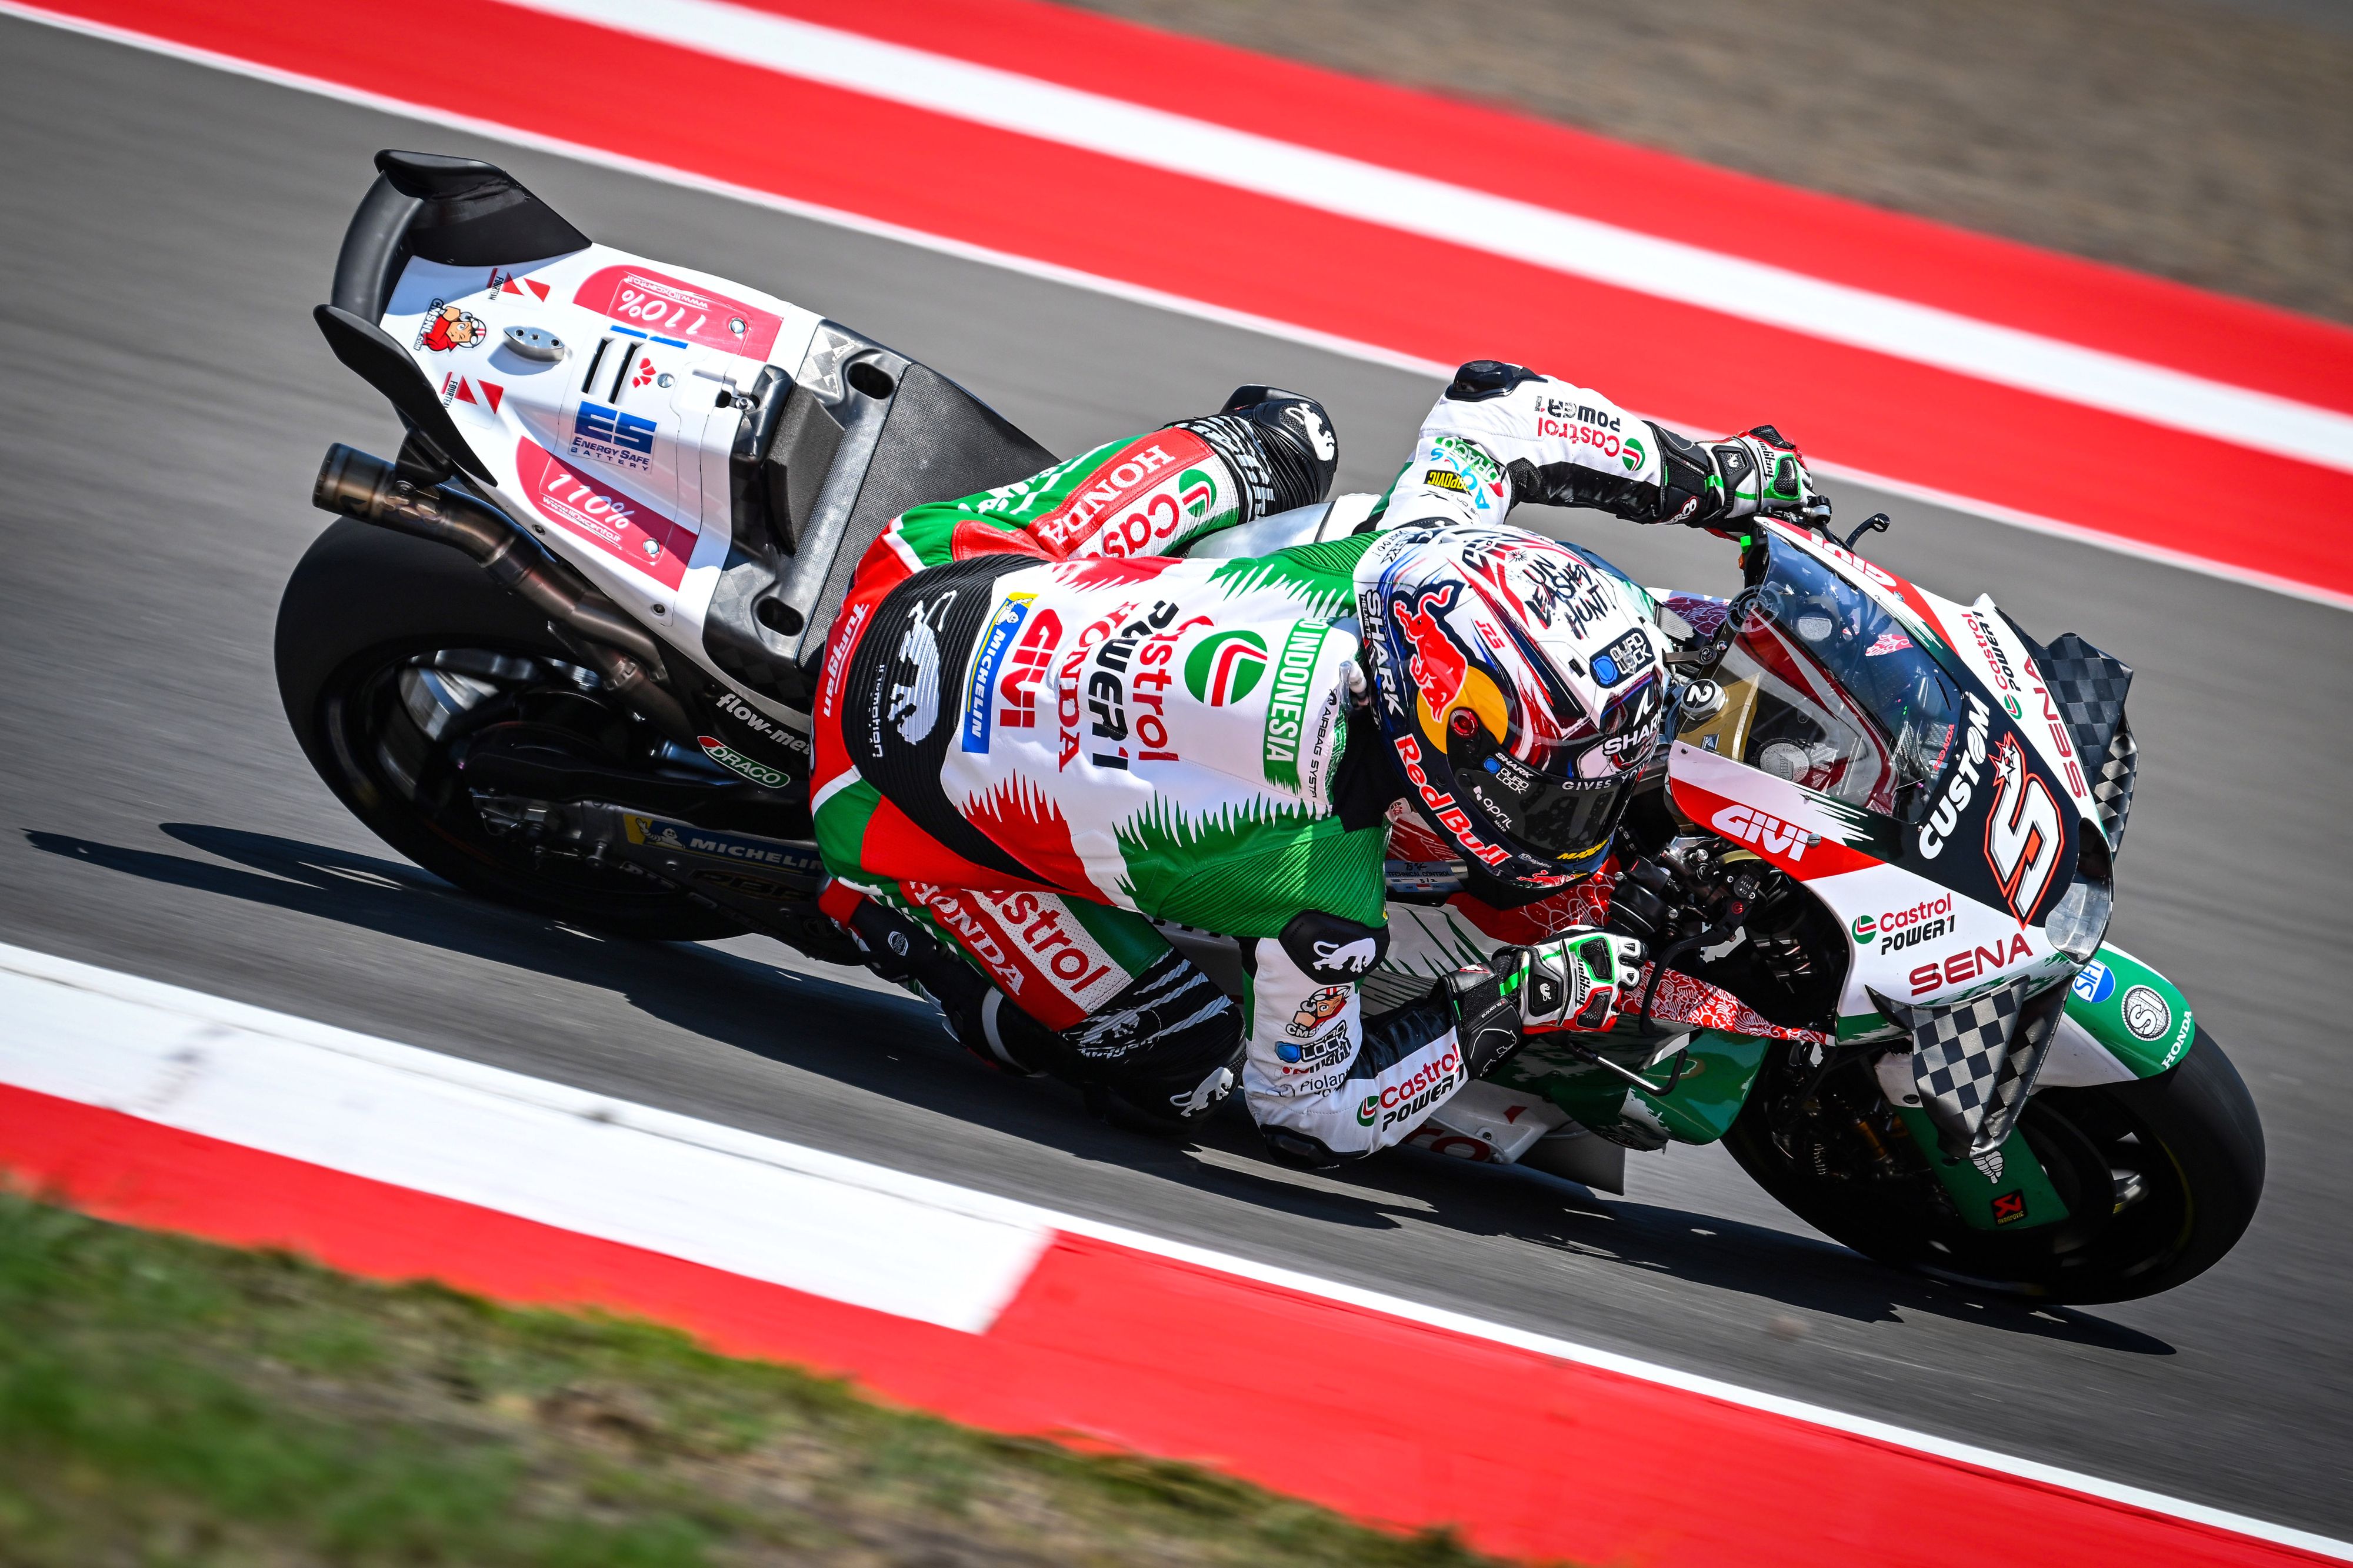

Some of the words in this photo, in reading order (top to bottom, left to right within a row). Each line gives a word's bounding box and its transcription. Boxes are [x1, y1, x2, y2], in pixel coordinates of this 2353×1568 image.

[618, 289, 706, 335] 110%
[572, 436, 619, 456] ENERGY
[620, 450, 650, 465] SAFE
[574, 400, 658, 454] ES
[1538, 417, 1620, 457] Castrol
[571, 446, 648, 471] BATTERY
[548, 473, 635, 529] 110%
[1037, 444, 1176, 546] HONDA
[1361, 596, 1371, 639] HELMETS
[999, 609, 1063, 728] GIVI
[1366, 589, 1405, 718] SHARK
[1961, 613, 2008, 690] Castrol
[1972, 610, 2021, 692] POWER1
[972, 629, 1006, 739] MICHELIN
[1058, 601, 1142, 773] HONDA
[1266, 630, 1323, 762] INDONESIA
[1314, 707, 1331, 756] AIRBAG
[2024, 655, 2088, 799] SENA
[708, 746, 781, 783] DRACO
[1495, 752, 1534, 779] SHARK
[1495, 772, 1527, 795] LOCK
[1500, 768, 1529, 789] QUAD
[1562, 779, 1612, 790] GIVES
[1919, 692, 1990, 860] CUSTOM
[1394, 734, 1457, 811] Red
[1435, 806, 1513, 867] Bull
[1483, 798, 1513, 829] april
[1494, 820, 1507, 832] Moto
[1711, 805, 1810, 862] GIVI
[1880, 892, 1952, 932] Castrol
[1881, 915, 1955, 956] POWER1
[1909, 933, 2034, 996] SENA
[1301, 1035, 1347, 1062] LOCK
[2161, 1010, 2192, 1069] HONDA
[1380, 1042, 1459, 1109] Castrol
